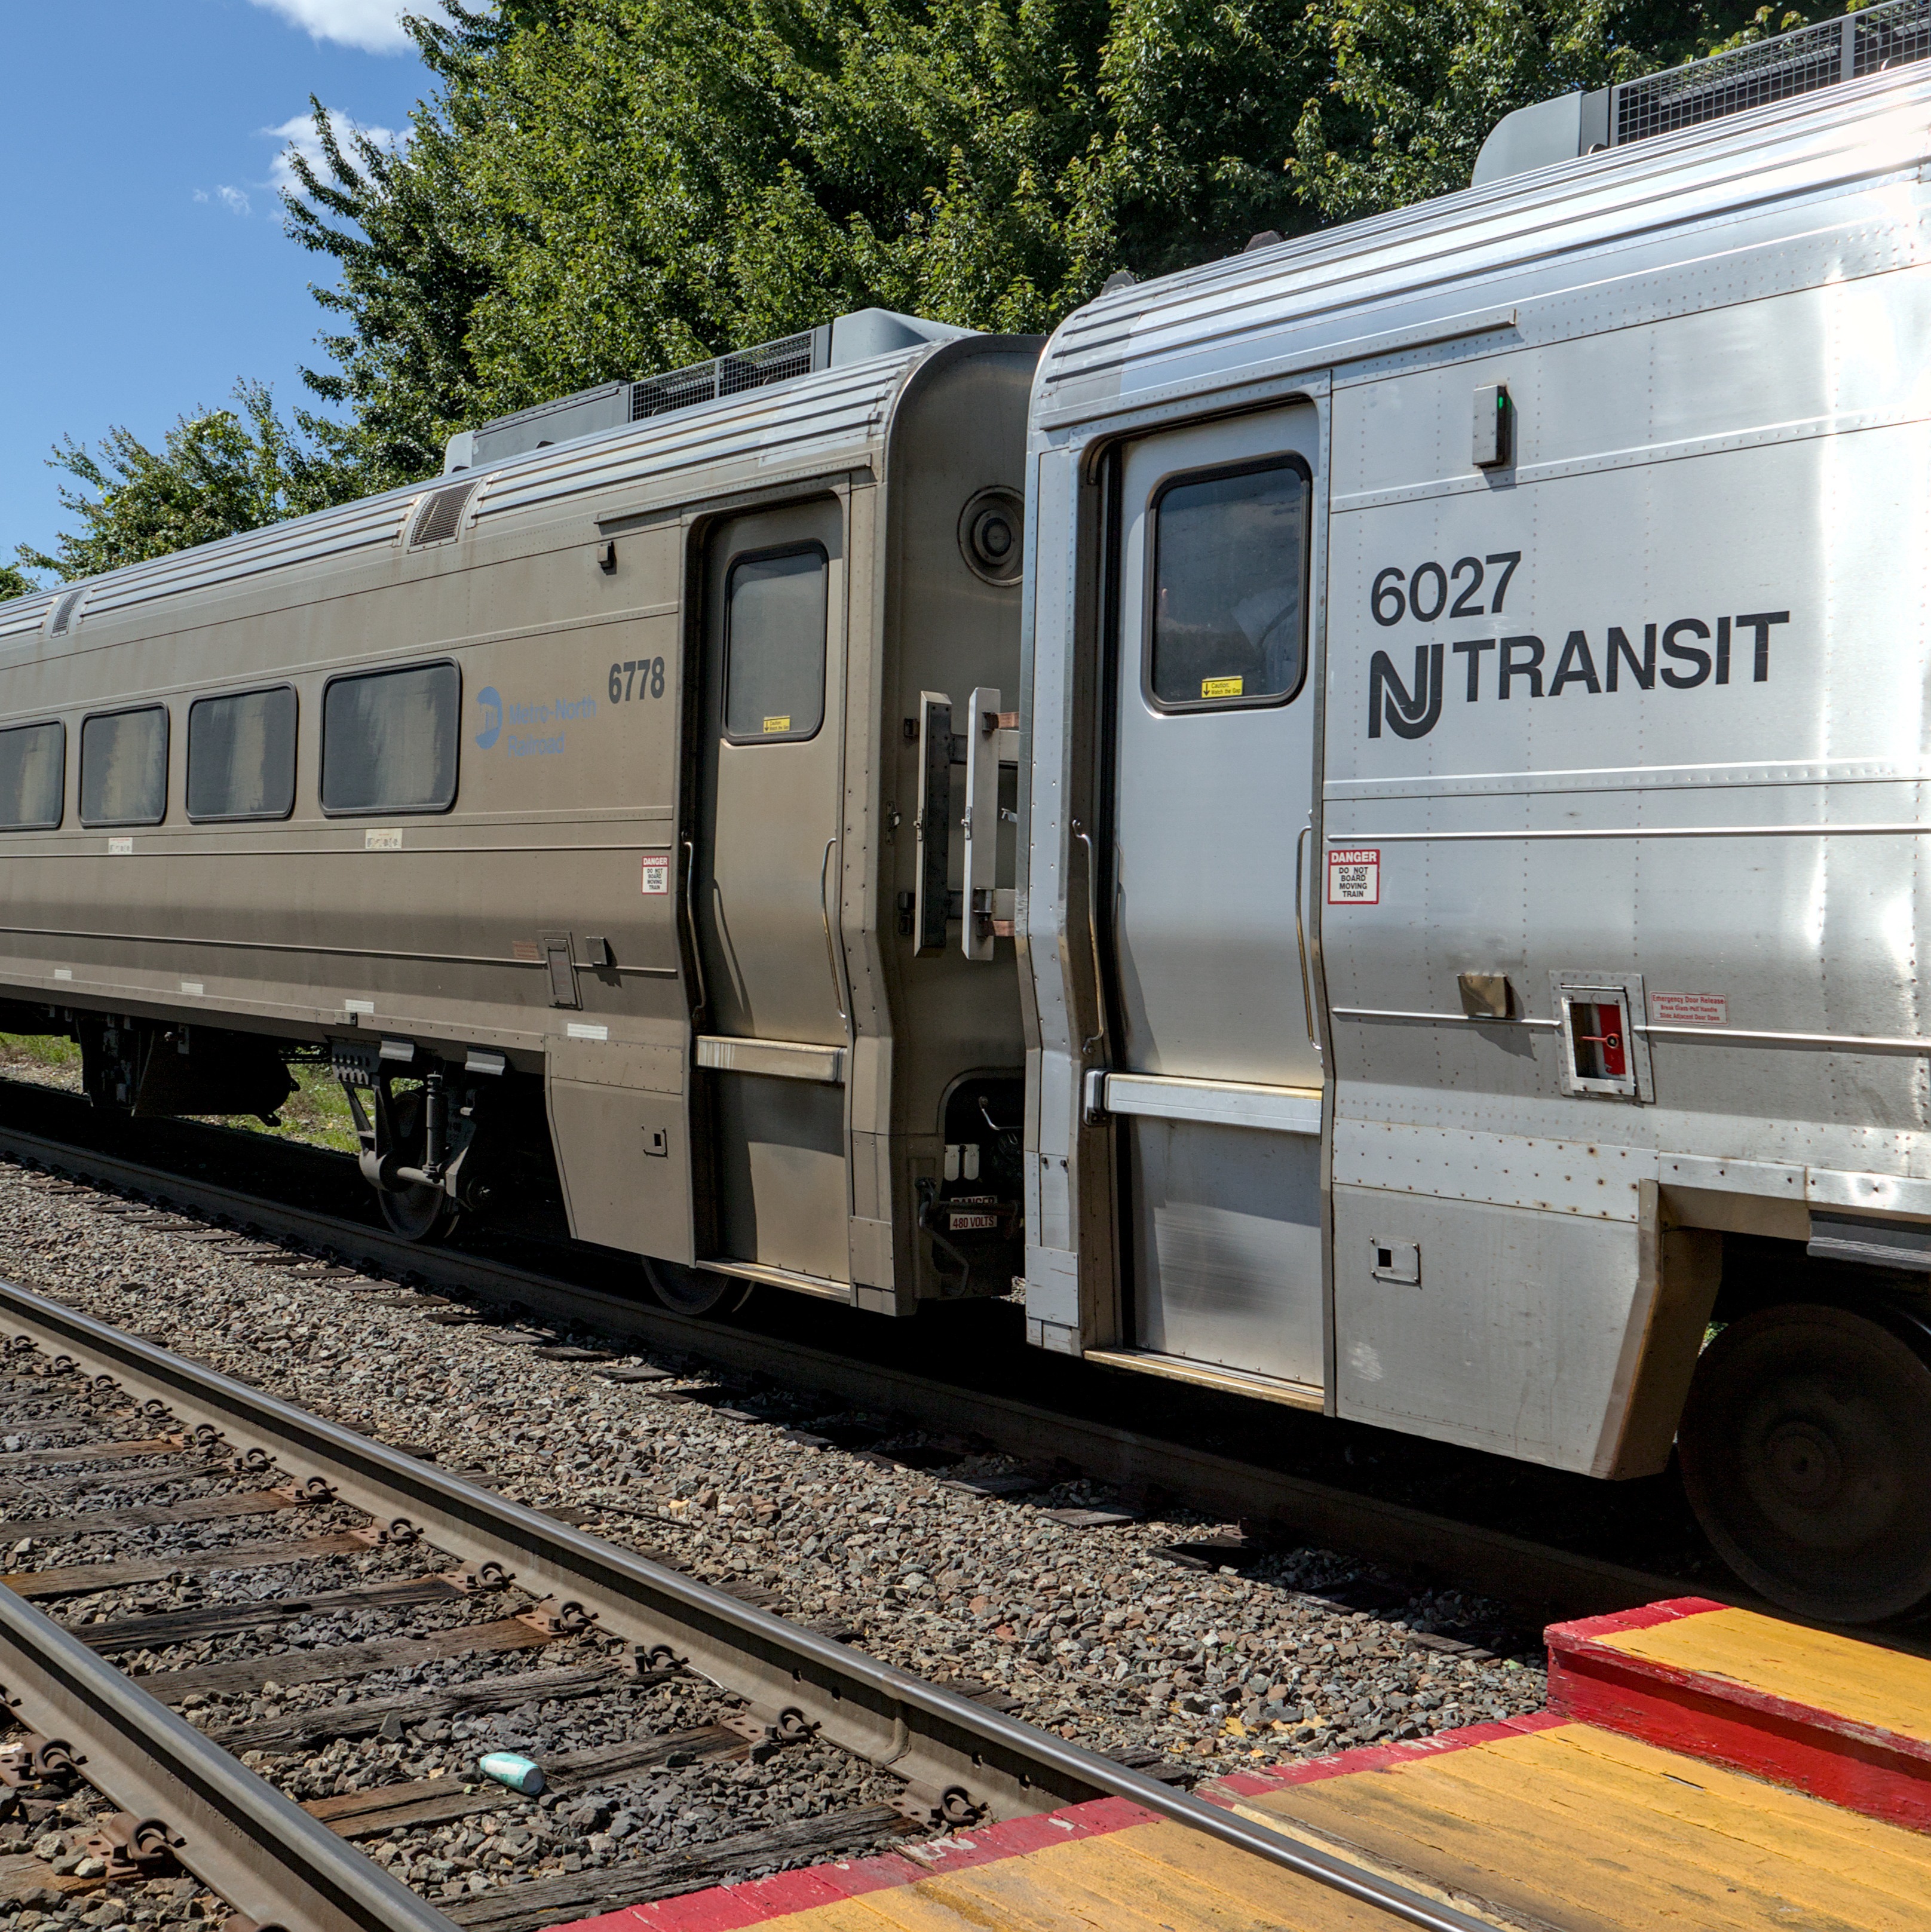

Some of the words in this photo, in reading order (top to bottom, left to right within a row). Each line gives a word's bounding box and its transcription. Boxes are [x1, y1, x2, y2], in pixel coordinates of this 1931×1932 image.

[1370, 550, 1522, 627] 6027
[608, 656, 665, 704] 6778
[1368, 643, 1445, 740] NJ
[1452, 610, 1790, 703] TRANSIT
[509, 695, 597, 725] Metro-North
[508, 731, 565, 758] Railroad
[643, 857, 668, 866] DANGER
[1331, 851, 1377, 863] DANGER
[1653, 995, 1684, 1004] Emergency
[953, 1218, 968, 1229] 480
[970, 1216, 994, 1228] VOLTS
